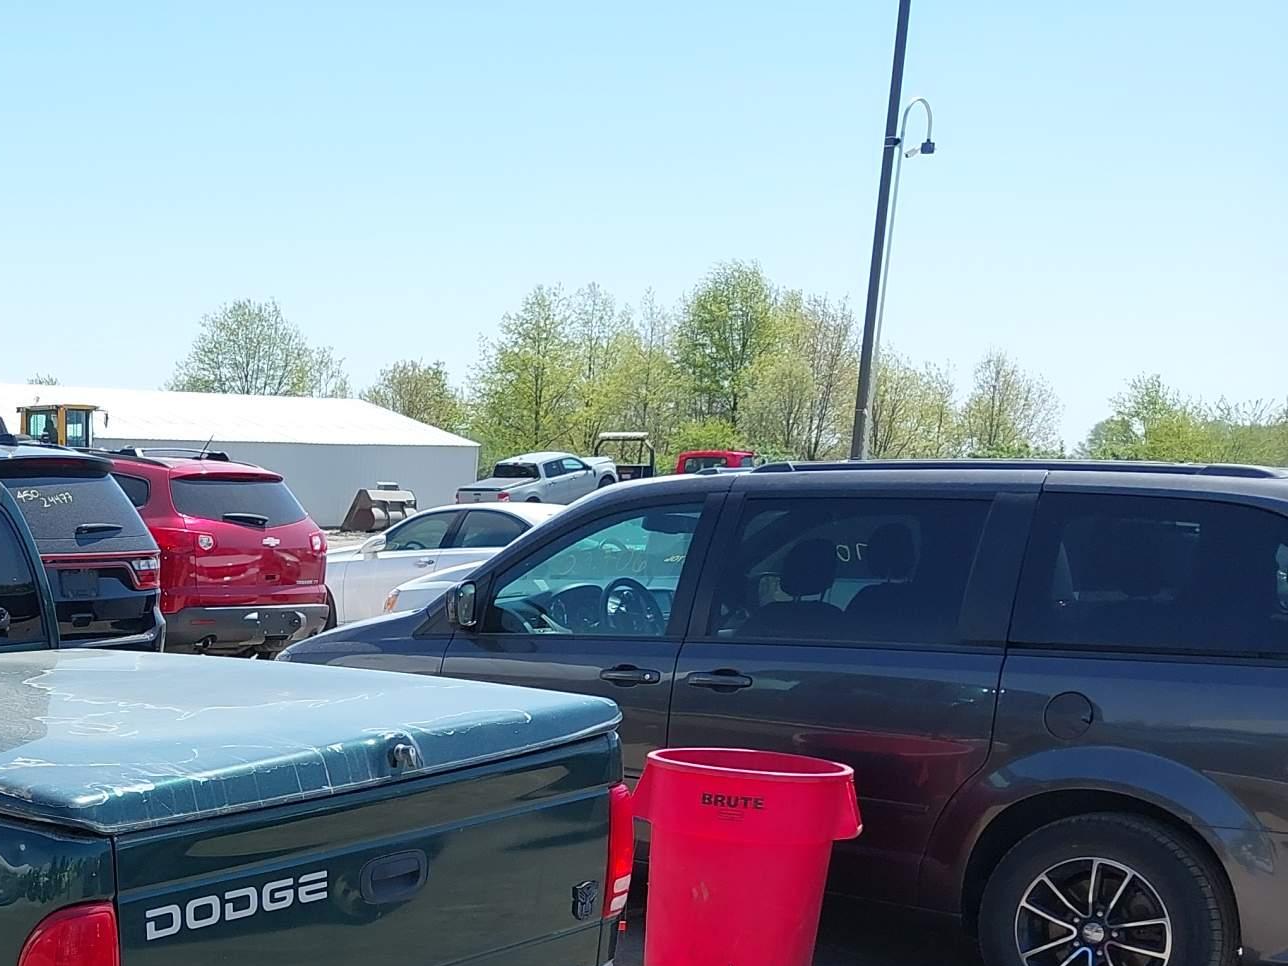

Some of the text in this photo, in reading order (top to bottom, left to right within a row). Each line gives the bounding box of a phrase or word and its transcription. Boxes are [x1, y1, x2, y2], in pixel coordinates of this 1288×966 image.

[16, 490, 39, 503] 450
[701, 793, 764, 810] BRUTE
[145, 870, 328, 941] DODGE
